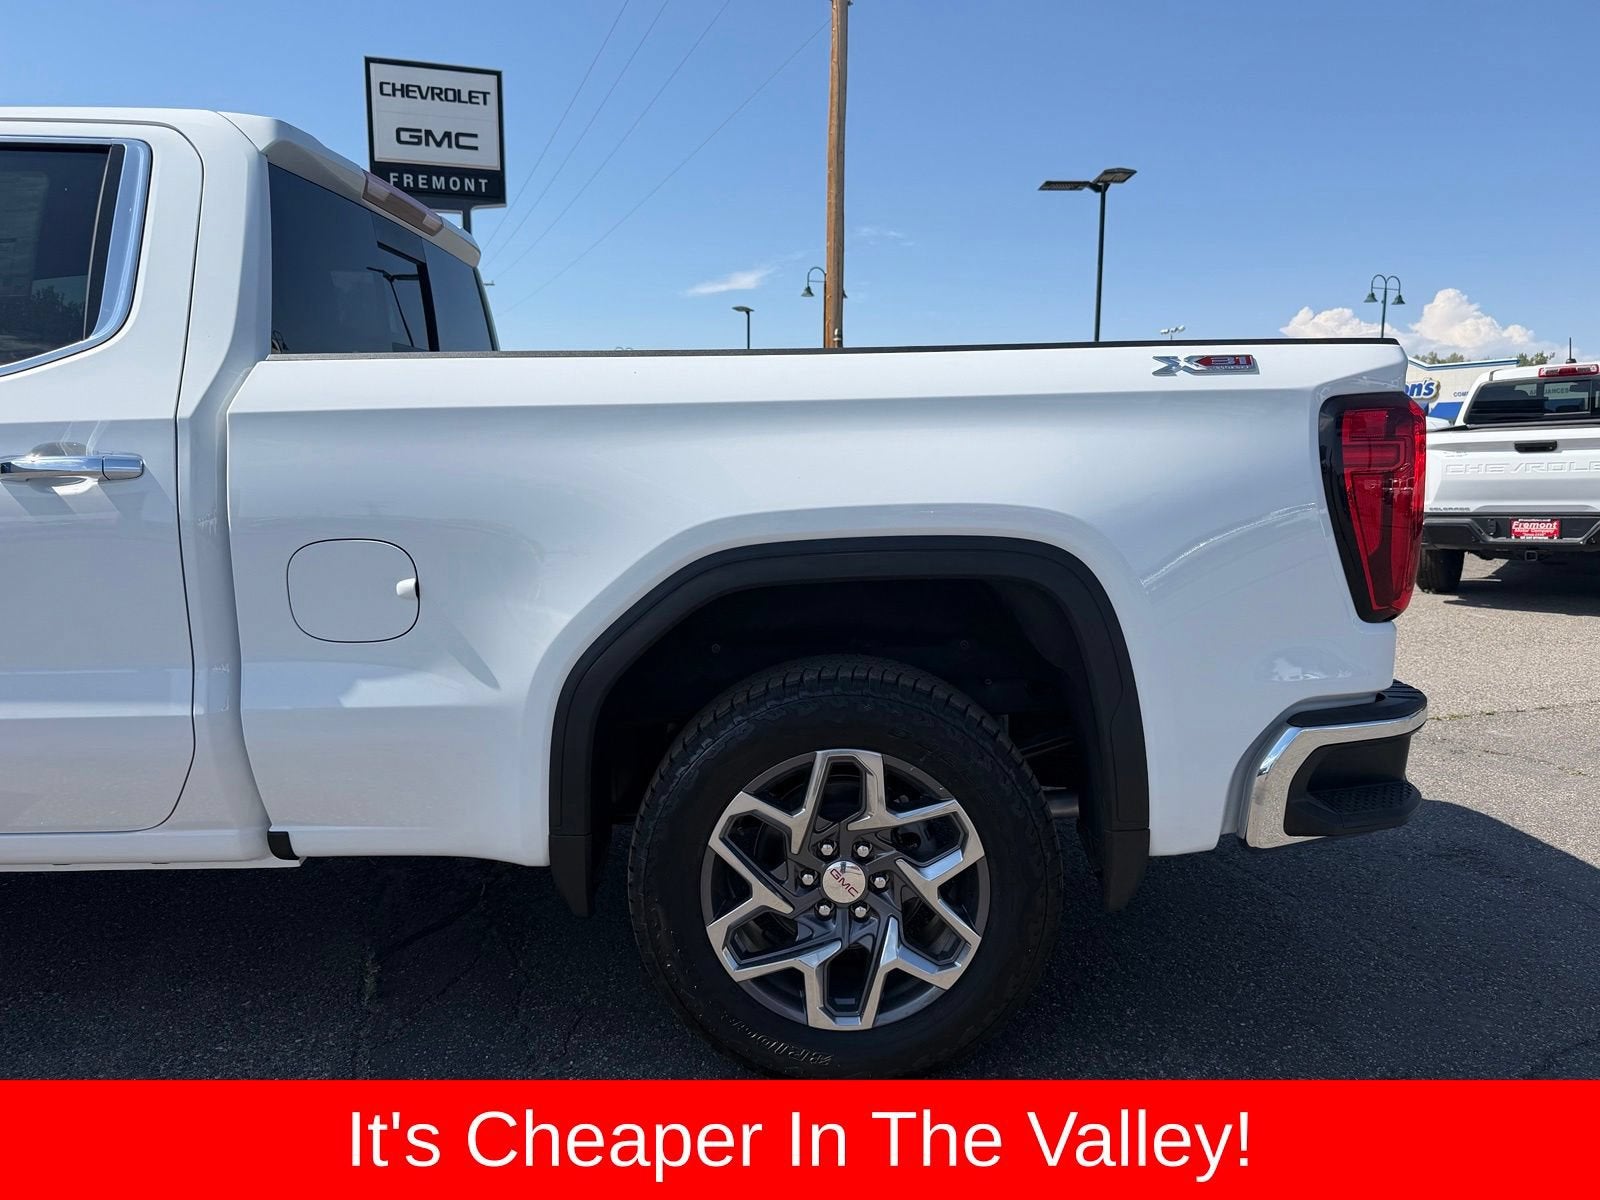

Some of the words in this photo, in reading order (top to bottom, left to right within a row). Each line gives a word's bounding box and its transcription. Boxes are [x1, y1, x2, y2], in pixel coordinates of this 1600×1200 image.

[380, 81, 490, 106] CHEVROLET
[396, 127, 479, 151] GMC
[389, 172, 488, 193] FREMONT
[1152, 354, 1260, 377] X31
[1511, 521, 1557, 530] Fremont
[830, 868, 859, 898] GMC
